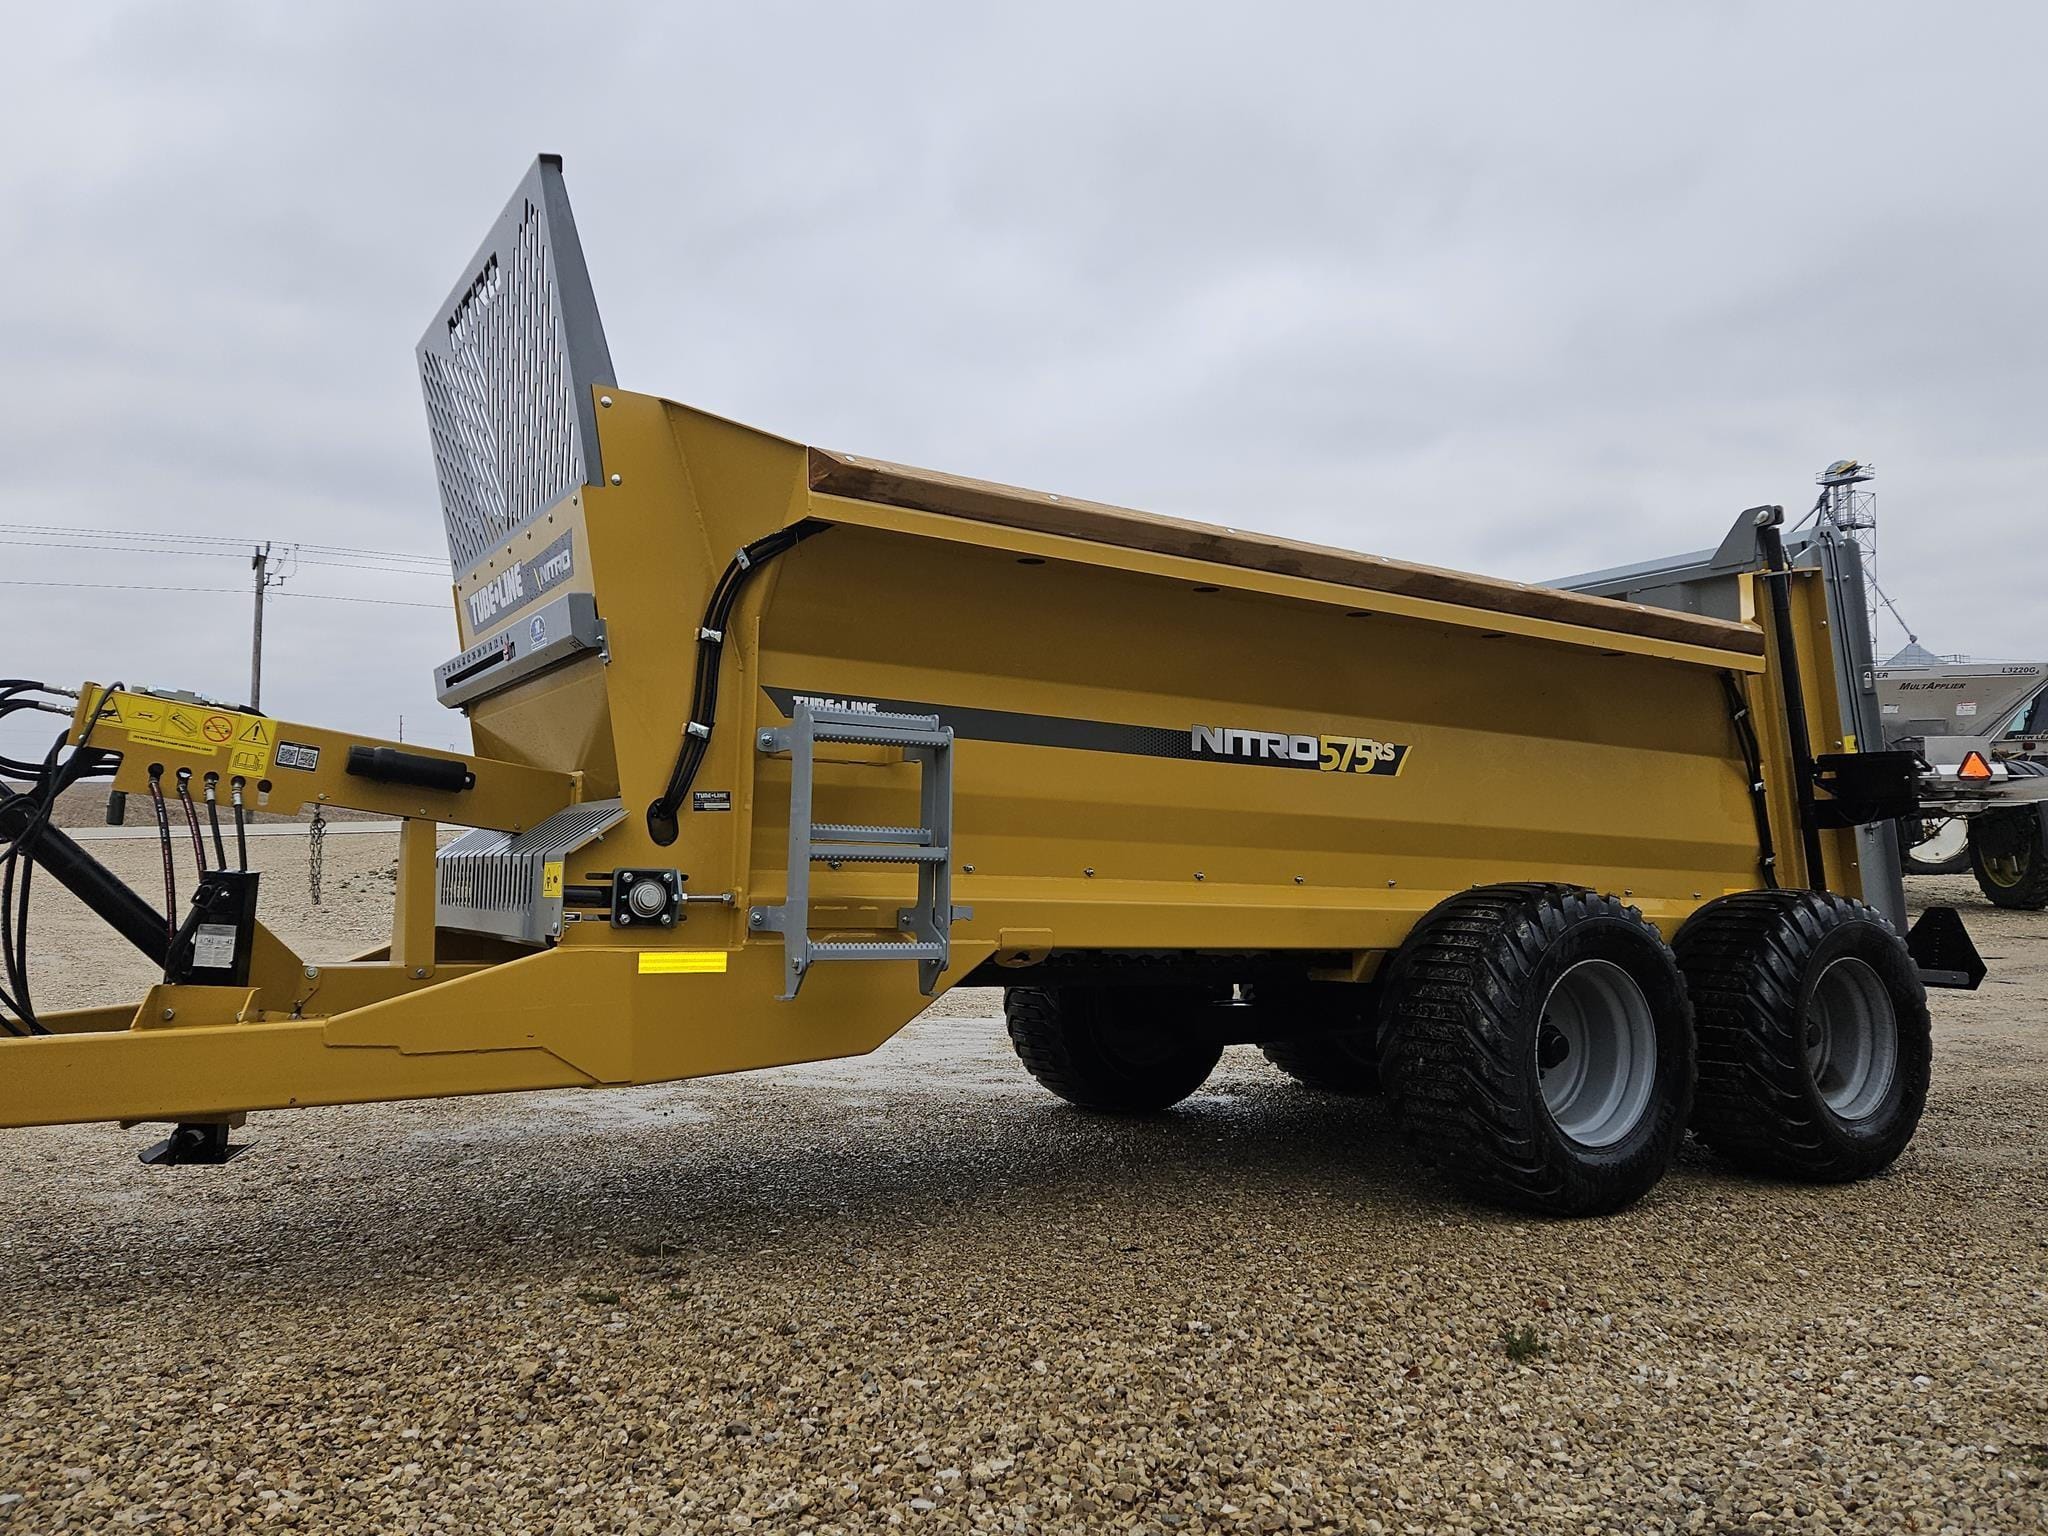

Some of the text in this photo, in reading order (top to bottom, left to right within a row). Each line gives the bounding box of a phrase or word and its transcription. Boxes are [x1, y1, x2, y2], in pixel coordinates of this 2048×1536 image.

[447, 251, 500, 351] NITRO
[538, 548, 571, 585] NITRO
[1191, 723, 1318, 762] NITRO
